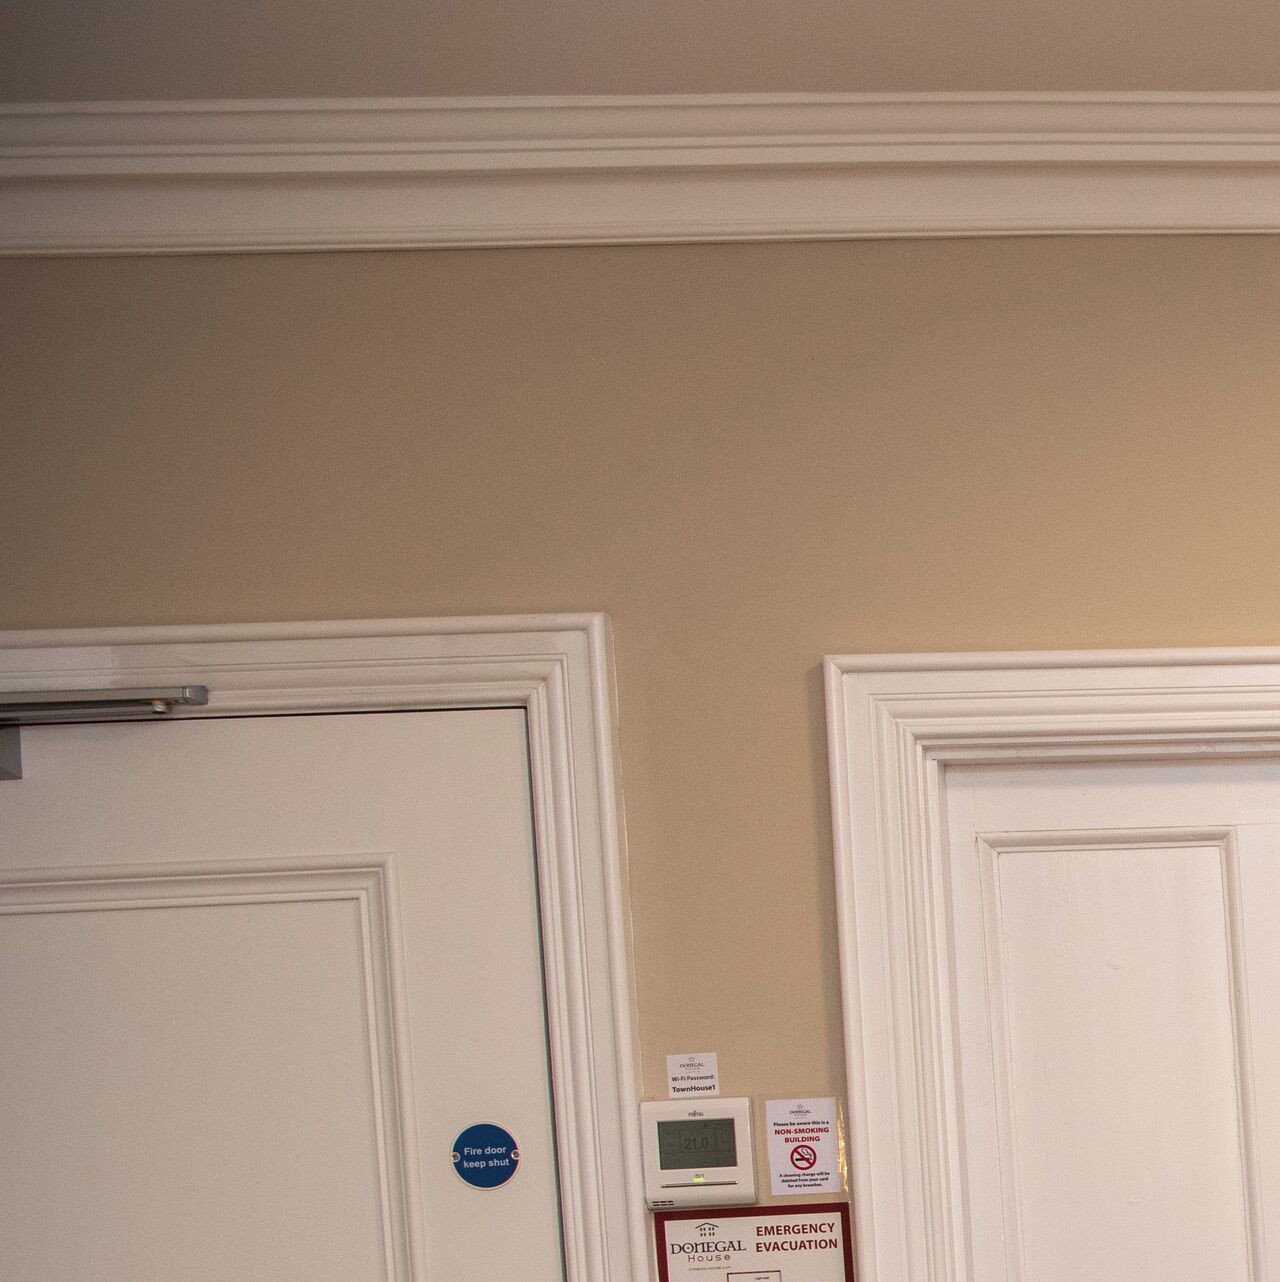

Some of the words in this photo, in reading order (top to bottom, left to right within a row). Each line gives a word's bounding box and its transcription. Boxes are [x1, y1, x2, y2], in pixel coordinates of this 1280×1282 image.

[671, 1084, 716, 1093] TownHouse1
[774, 1126, 830, 1136] NON-SMOKING
[784, 1135, 821, 1144] BUILDING
[463, 1147, 482, 1156] Fire
[484, 1146, 507, 1155] door
[463, 1160, 486, 1169] keep
[488, 1158, 510, 1167] shut
[756, 1222, 836, 1237] EMERGENCY
[670, 1240, 747, 1255] DONEGAL
[755, 1238, 838, 1253] EVACUATION
[687, 1254, 731, 1263] House
